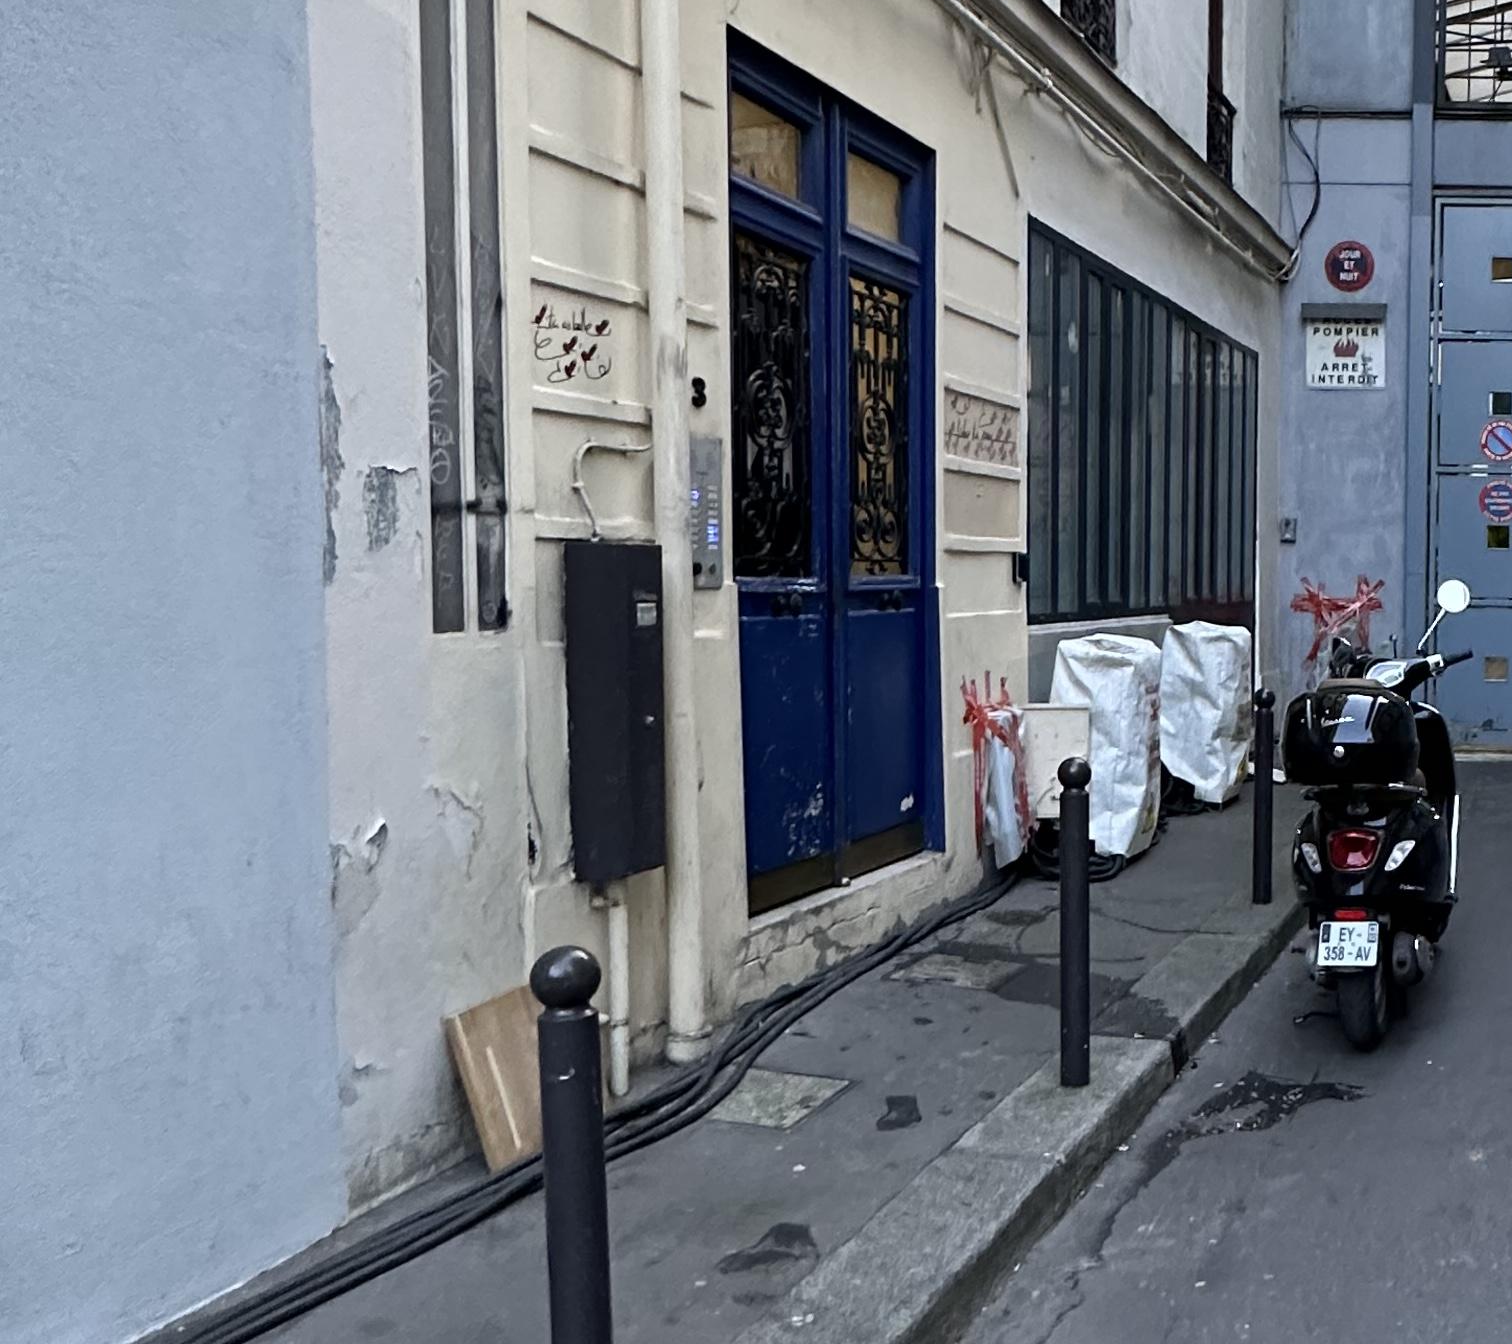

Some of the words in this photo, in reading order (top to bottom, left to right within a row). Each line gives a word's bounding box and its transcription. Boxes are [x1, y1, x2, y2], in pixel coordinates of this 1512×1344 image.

[1338, 250, 1361, 260] JOUR
[1339, 271, 1360, 281] NUIT
[1312, 326, 1379, 337] POMPIER
[1320, 362, 1368, 373] ARRET
[1311, 374, 1379, 385] INTERDIT
[691, 377, 707, 409] 3
